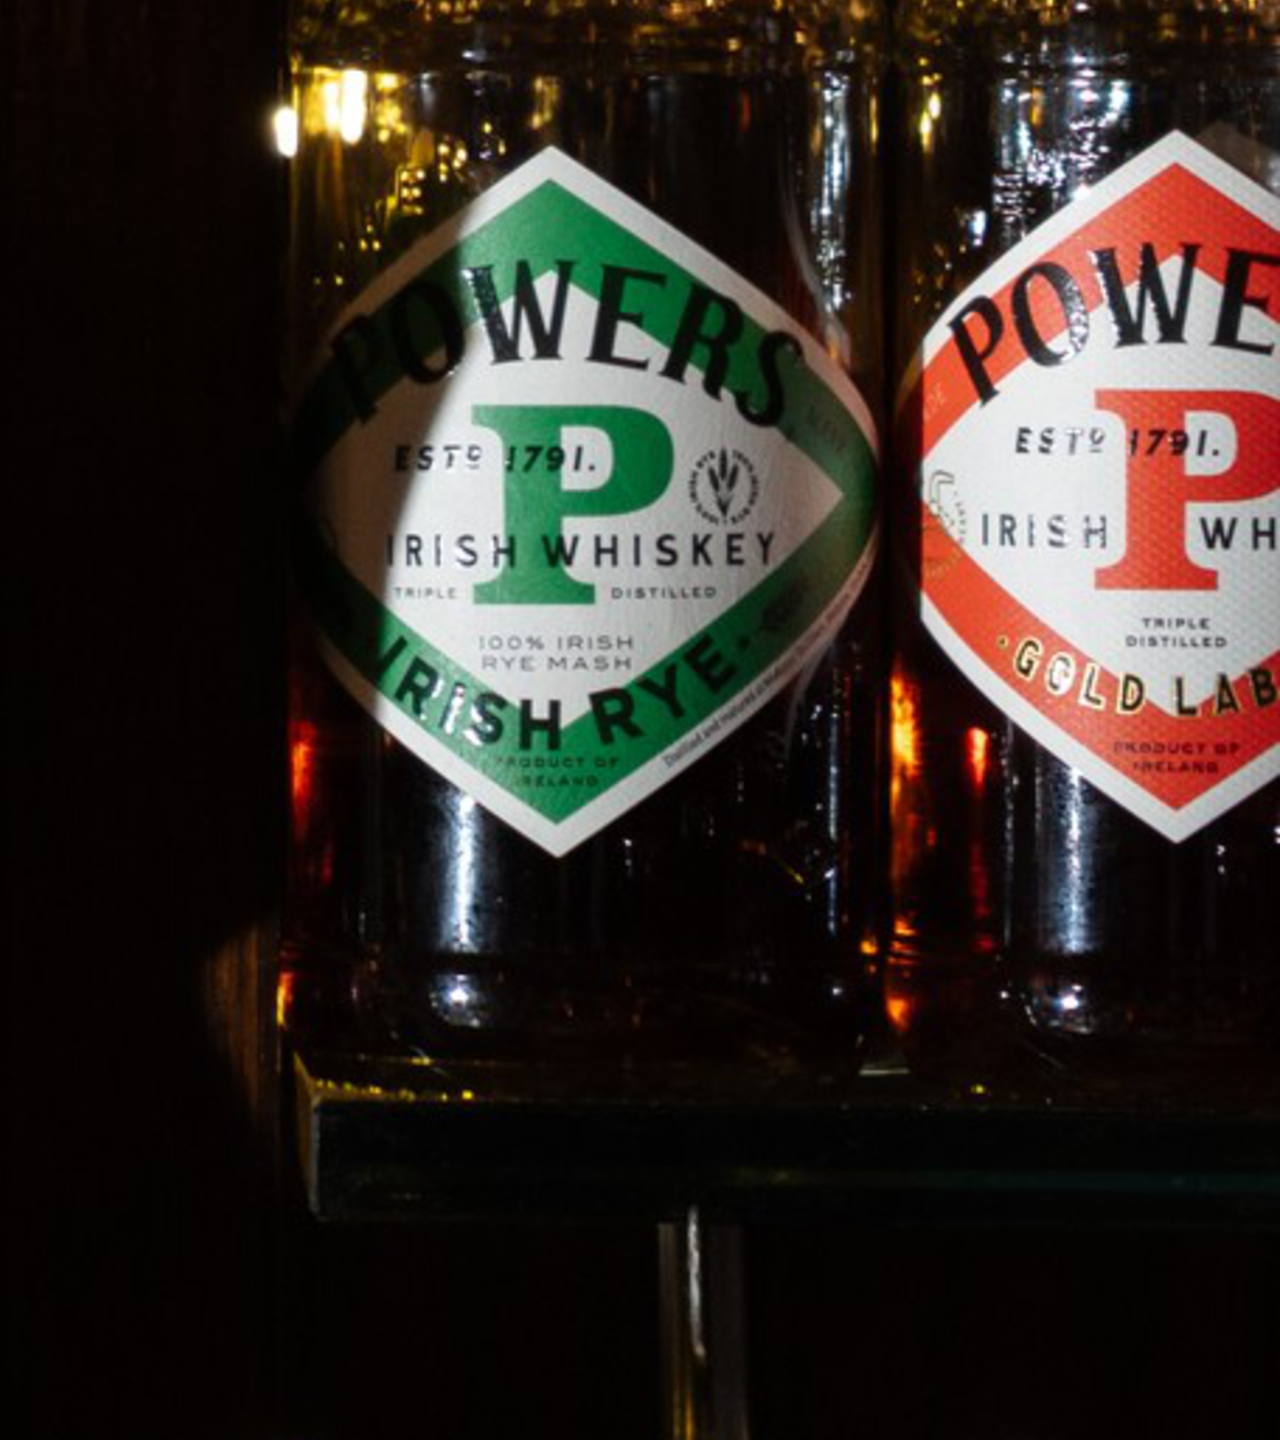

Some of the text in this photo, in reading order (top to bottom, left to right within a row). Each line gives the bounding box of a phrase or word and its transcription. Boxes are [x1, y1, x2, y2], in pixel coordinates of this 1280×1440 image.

[329, 257, 804, 427] POWERS
[981, 513, 1108, 550] IRISH
[387, 531, 777, 568] IRISH WHISKEY
[610, 585, 718, 601] DISTILLED
[1142, 617, 1211, 630] TRIPLE
[478, 634, 635, 652] 100% IRISH
[1125, 635, 1229, 649] DISTILLED
[480, 654, 634, 672] RYE MASH
[1015, 638, 1147, 716] GOLD
[587, 636, 739, 746] RYE
